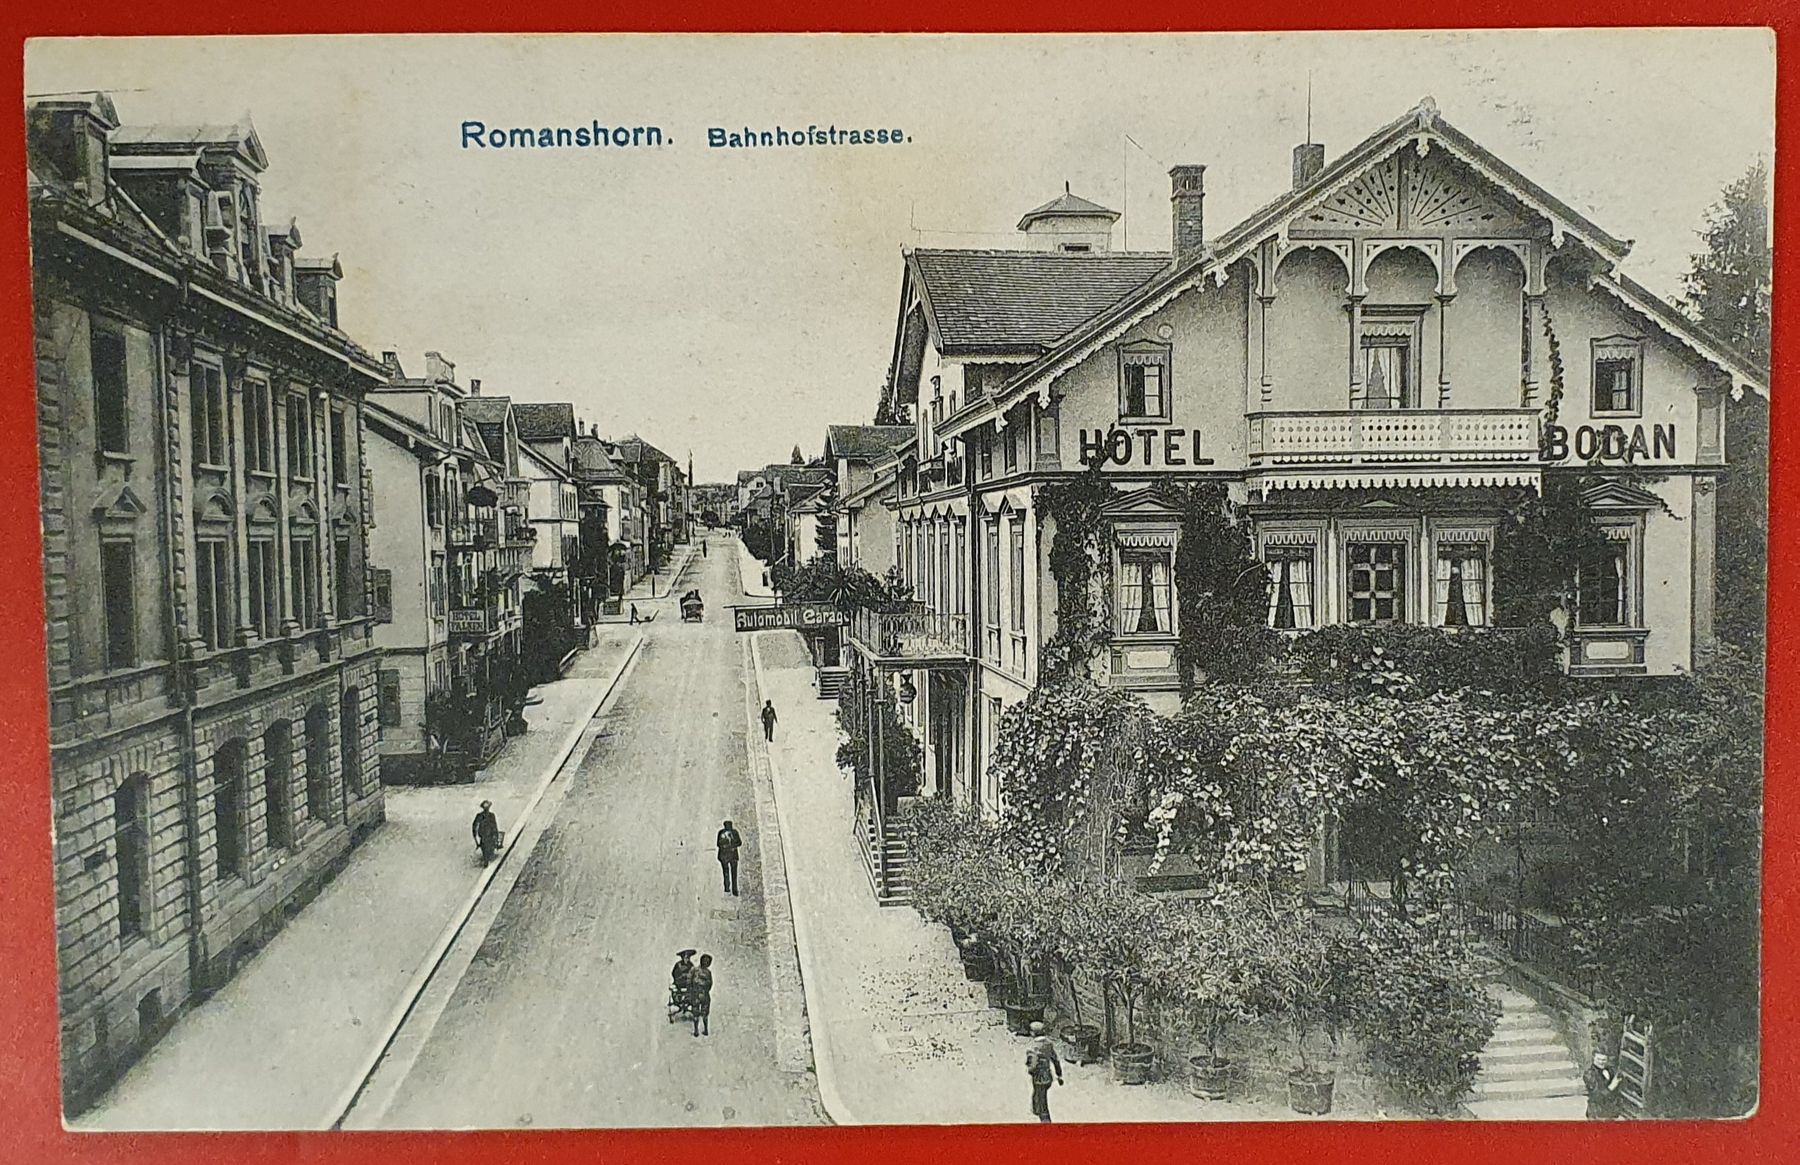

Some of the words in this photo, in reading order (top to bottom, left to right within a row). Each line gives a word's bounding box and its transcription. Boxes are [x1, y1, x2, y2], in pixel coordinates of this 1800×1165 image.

[461, 120, 674, 149] Romanshorn.
[708, 126, 914, 148] Bahnhofstrasse.
[1079, 429, 1215, 466] HOTEL
[1544, 424, 1676, 461] BODAN
[452, 611, 481, 621] HOTEL
[736, 610, 799, 628] Automobil
